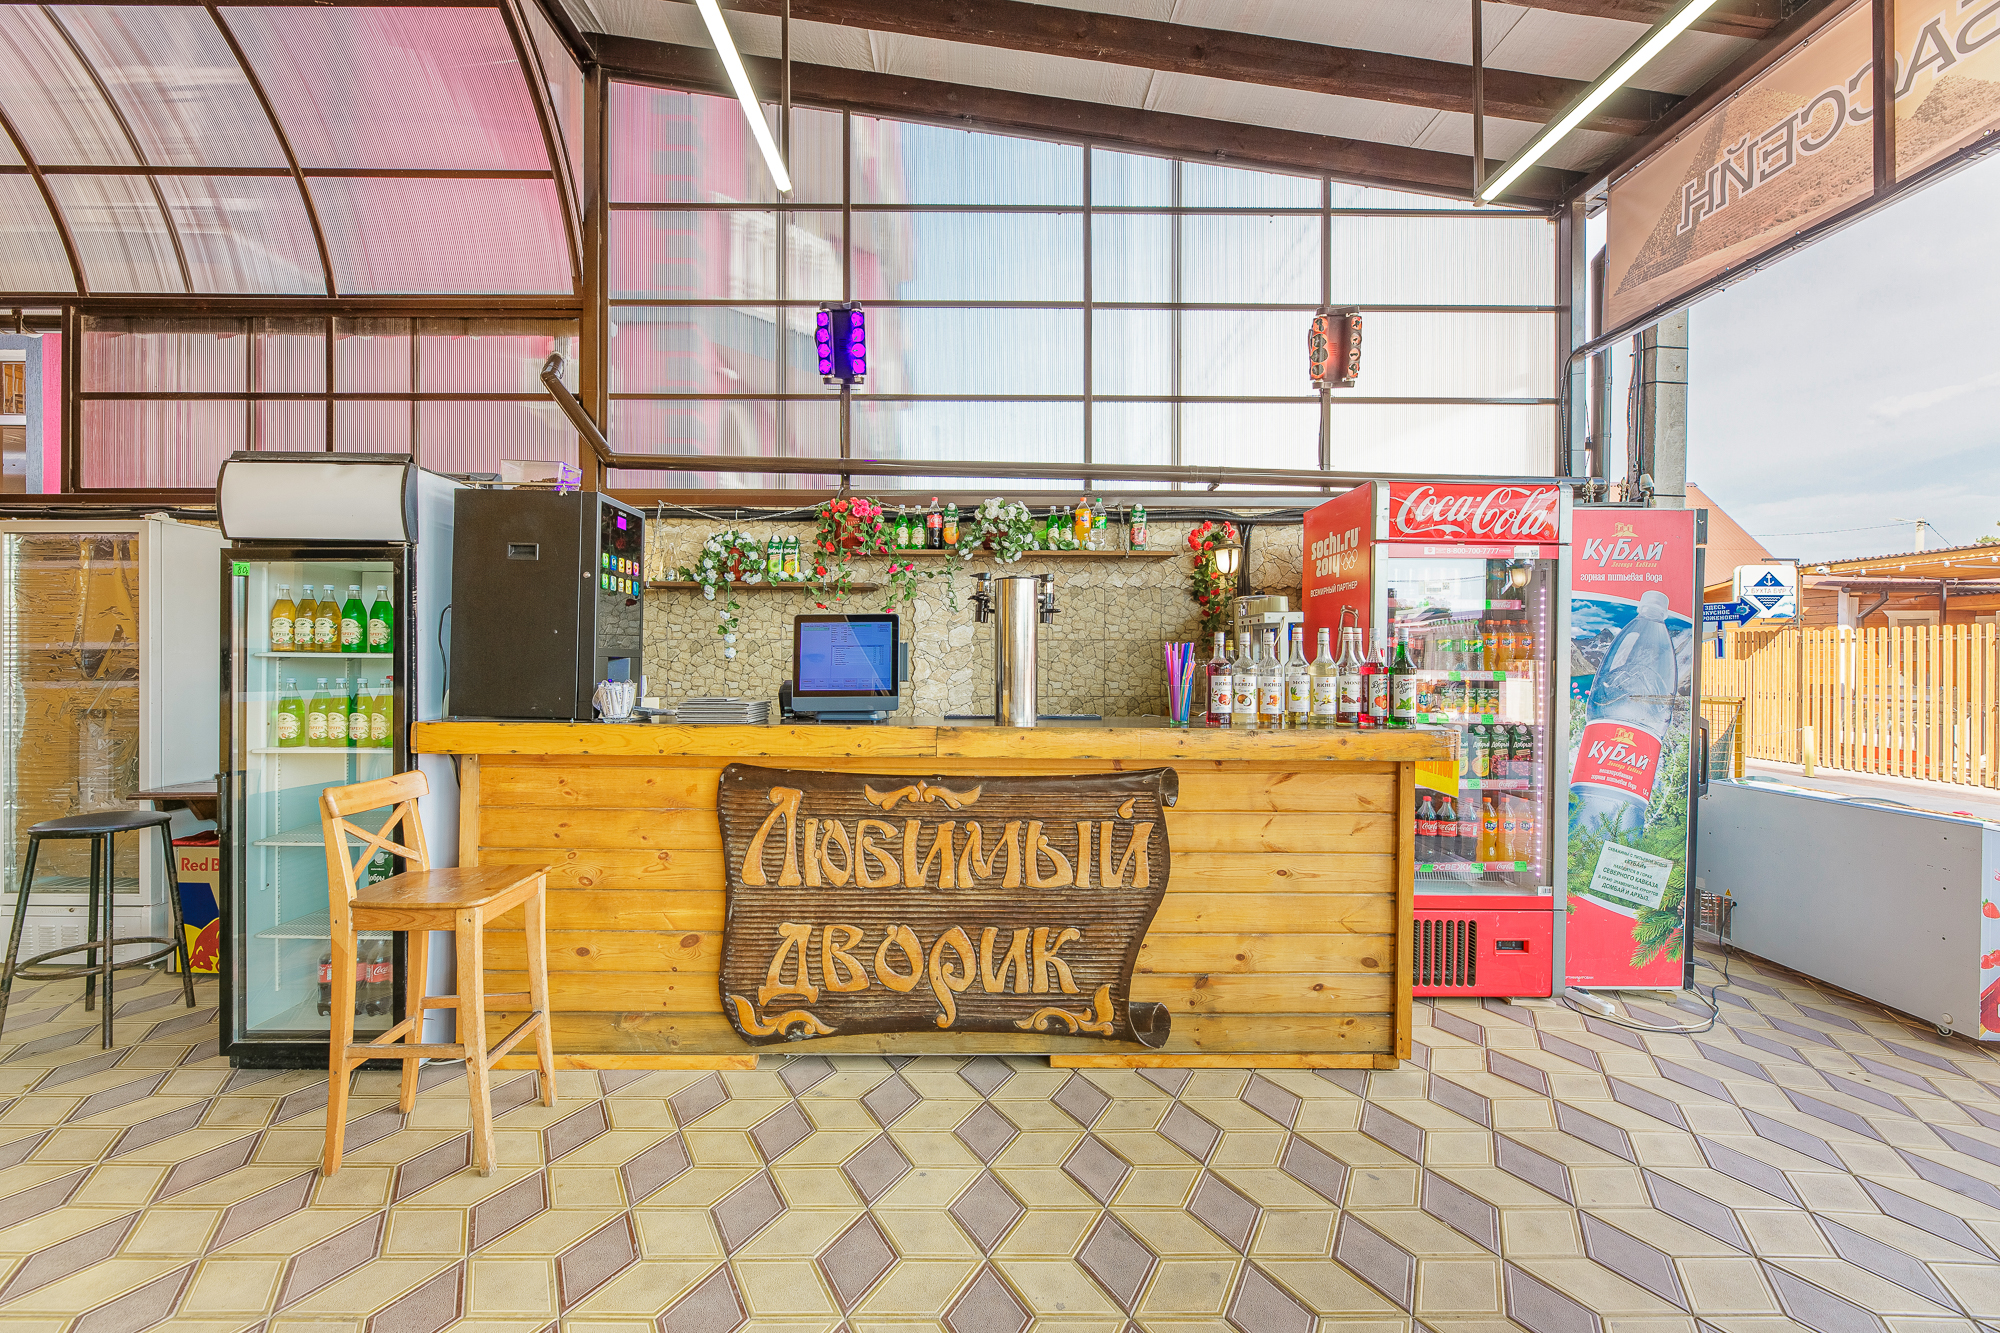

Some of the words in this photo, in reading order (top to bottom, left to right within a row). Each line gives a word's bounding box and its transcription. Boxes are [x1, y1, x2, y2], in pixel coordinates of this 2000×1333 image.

[1396, 485, 1557, 536] Coca-Cola
[1311, 527, 1359, 561] sochi.ru
[1315, 553, 1341, 578] 2014
[1580, 573, 1606, 583] горная
[1607, 572, 1644, 582] питьевая
[1645, 572, 1663, 583] вода
[1310, 583, 1337, 598] ВСЕМИРНЫЙ
[1336, 580, 1358, 592] ПАРТНЕР
[741, 785, 1156, 889] ЛЮБИМЫЙ
[181, 857, 209, 871] Red
[1601, 882, 1625, 894] ДОМБАЙ
[1602, 866, 1635, 881] СЕВЕРНОГО
[1635, 877, 1659, 889] КАВКАЗА
[757, 921, 1081, 1028] ДВОРИК
